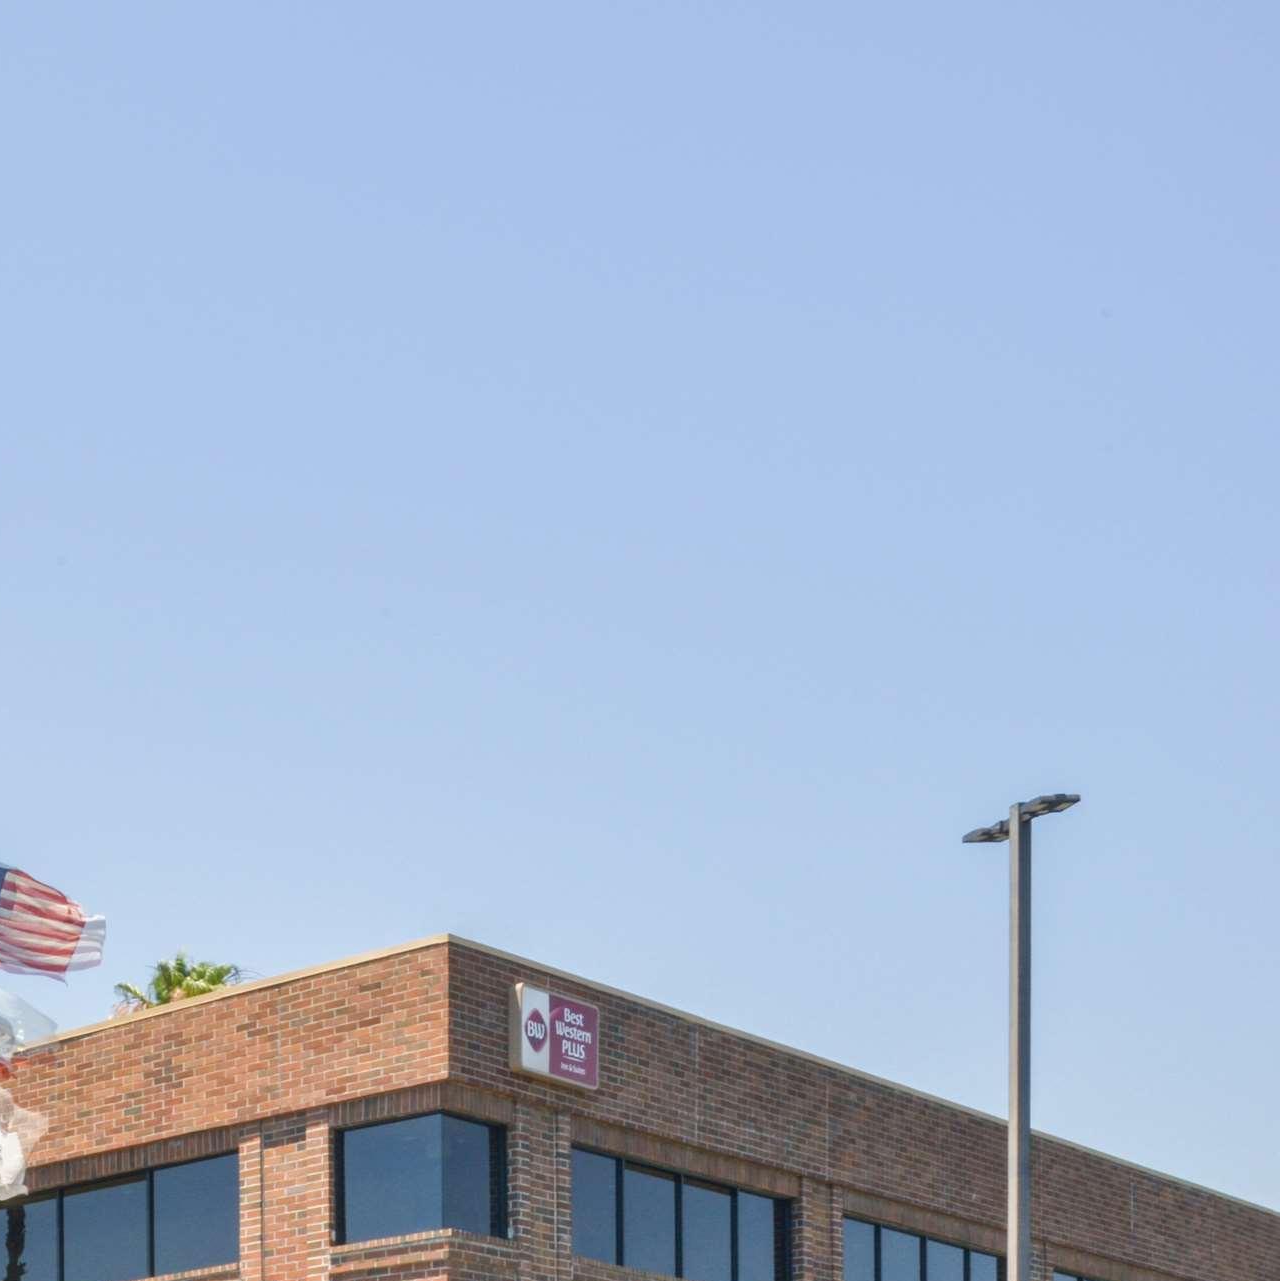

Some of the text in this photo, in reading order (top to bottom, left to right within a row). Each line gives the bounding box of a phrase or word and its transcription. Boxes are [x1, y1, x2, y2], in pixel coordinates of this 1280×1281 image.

[564, 1007, 584, 1026] Best
[527, 1020, 545, 1039] BW
[555, 1020, 592, 1044] Western
[562, 1039, 586, 1059] PLUS
